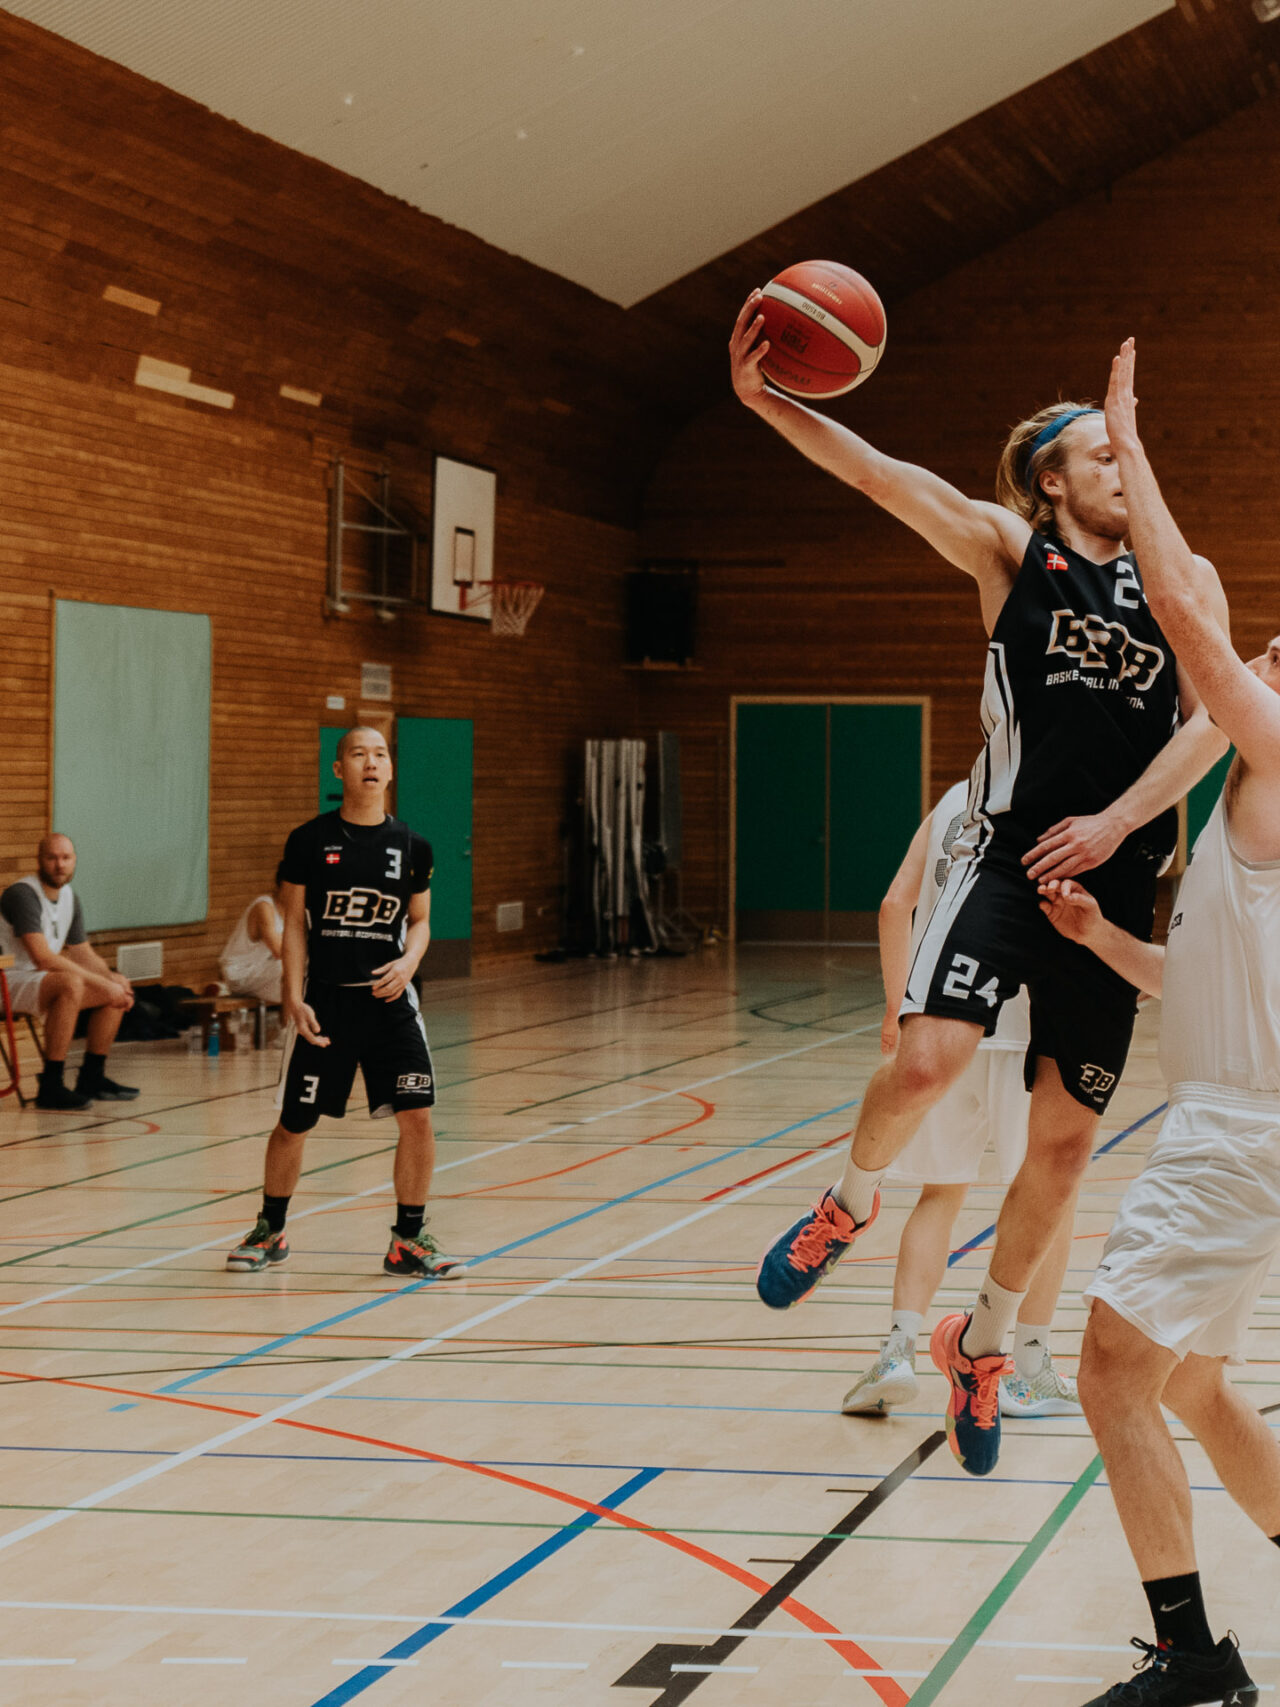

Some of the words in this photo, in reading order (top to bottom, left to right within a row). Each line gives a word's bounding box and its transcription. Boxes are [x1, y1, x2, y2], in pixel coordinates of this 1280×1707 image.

[1114, 560, 1148, 610] 2
[1045, 669, 1105, 690] BASKEALL
[385, 847, 402, 880] 3
[322, 887, 401, 927] B3B
[942, 953, 999, 1008] 24
[300, 1075, 320, 1104] 3
[396, 1073, 432, 1090] B3B
[1079, 1063, 1116, 1092] 3B
